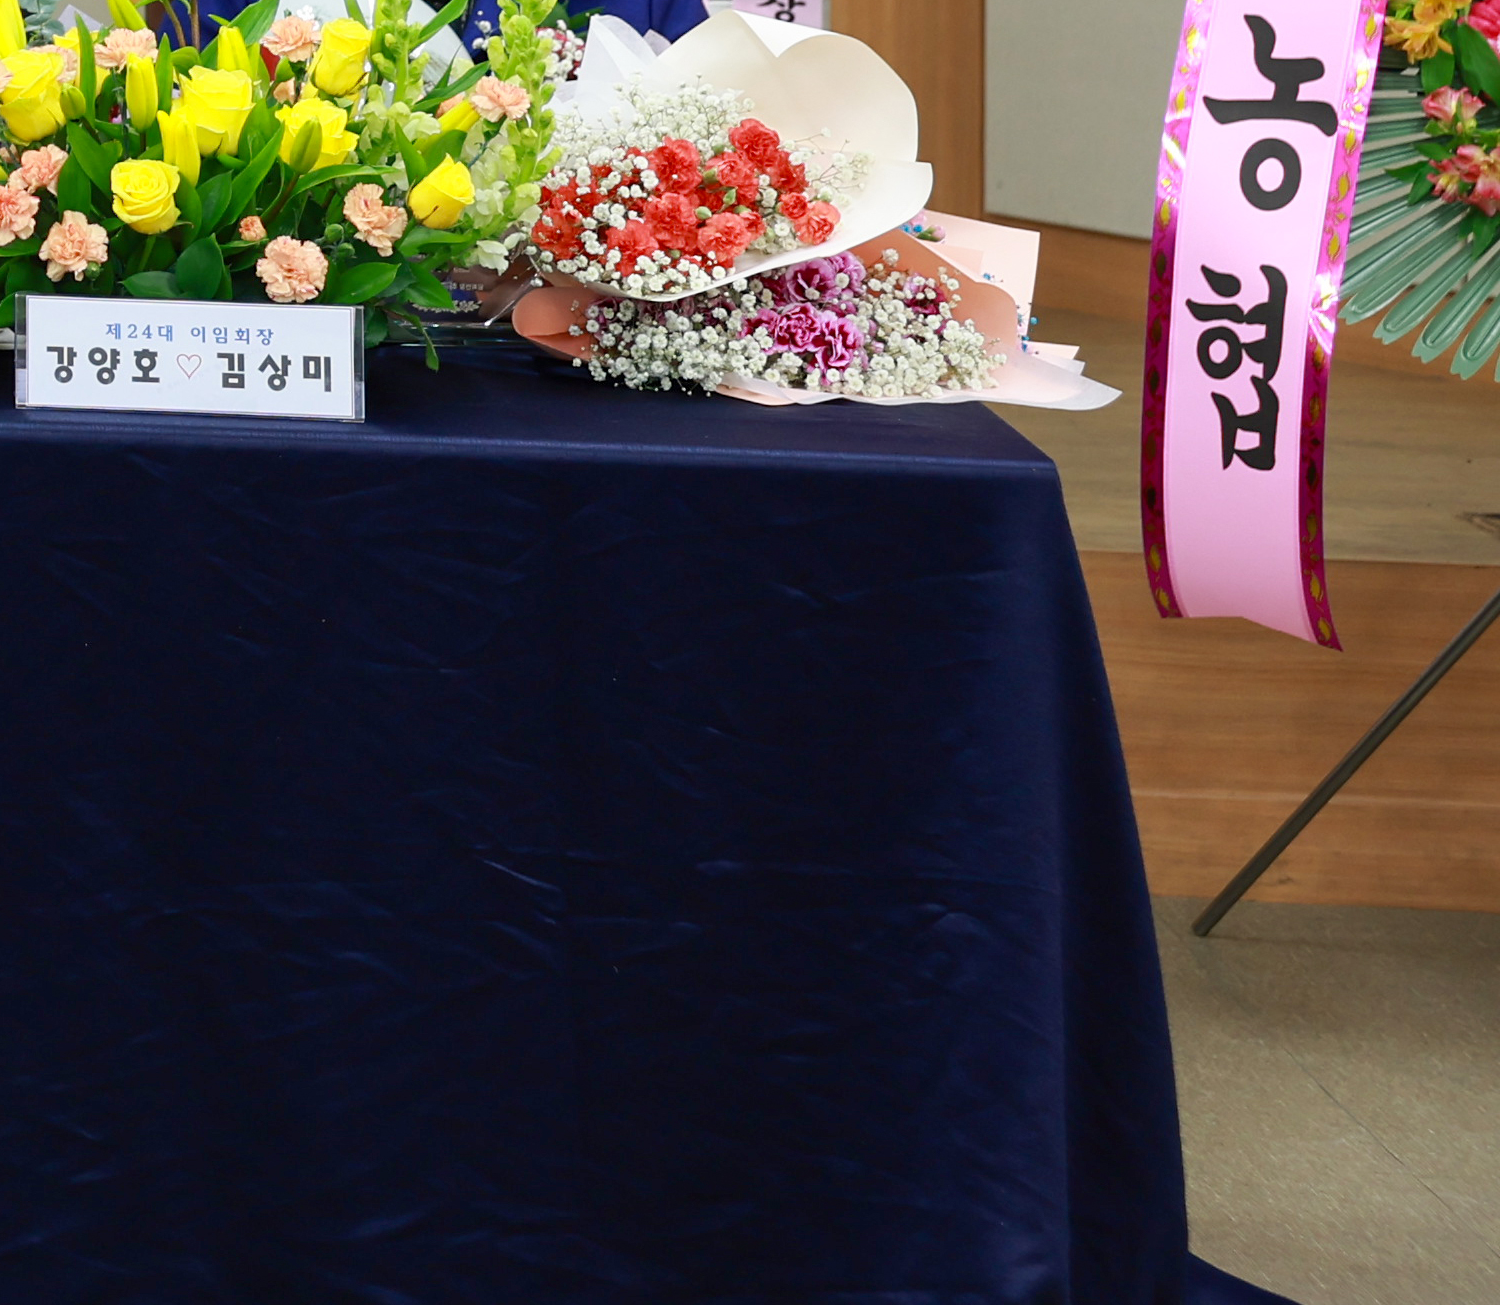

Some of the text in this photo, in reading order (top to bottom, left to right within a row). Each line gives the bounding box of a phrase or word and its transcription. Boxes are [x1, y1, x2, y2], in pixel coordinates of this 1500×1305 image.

[105, 322, 275, 346] 제24대 이임회장
[46, 345, 332, 393] 강양호 김상미
